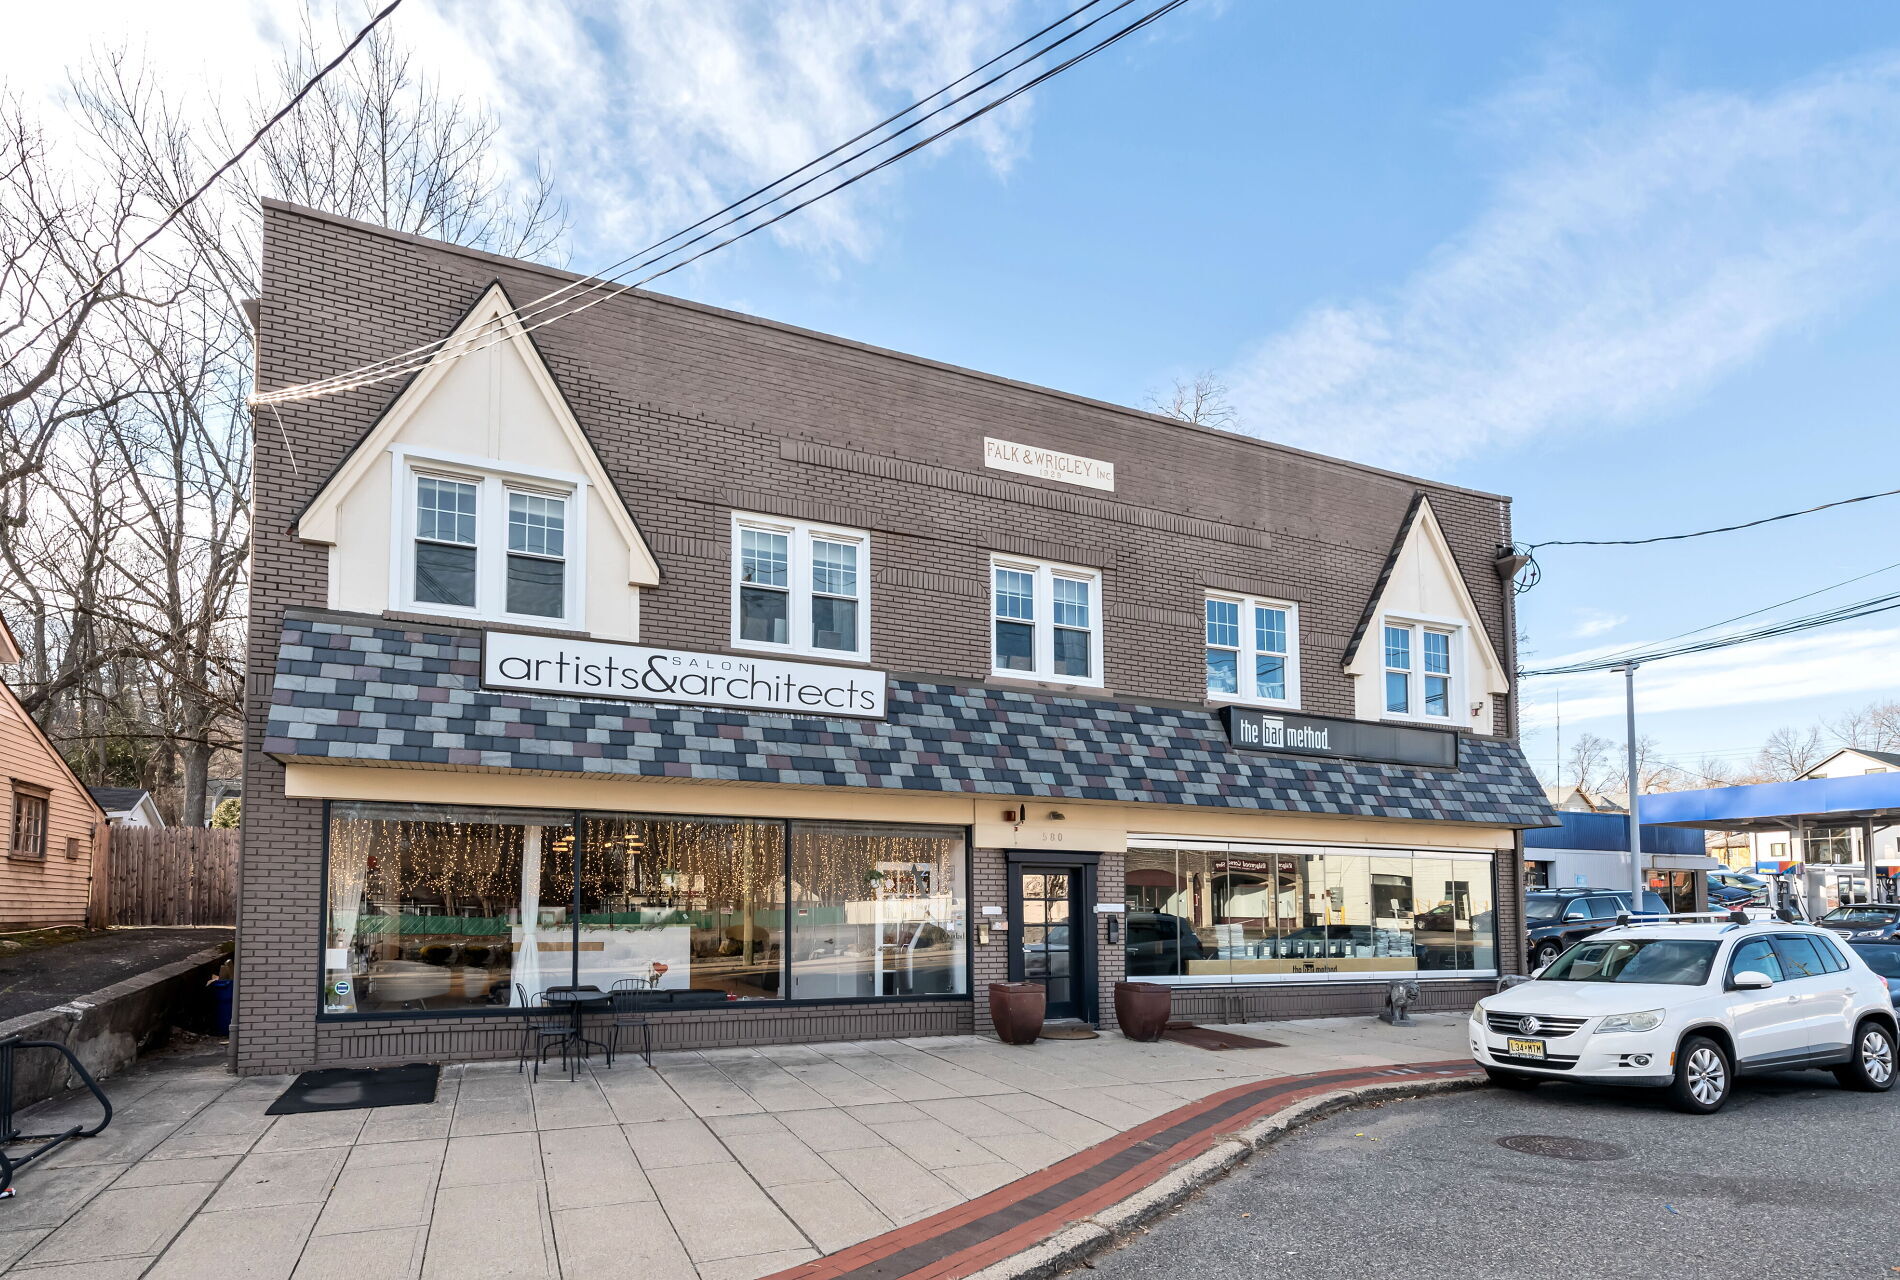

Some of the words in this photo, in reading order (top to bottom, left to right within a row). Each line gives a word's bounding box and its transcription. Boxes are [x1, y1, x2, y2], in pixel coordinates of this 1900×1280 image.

[987, 441, 1019, 463] FALK
[1022, 449, 1033, 465] &
[1035, 451, 1093, 477] WRIGLEY
[672, 656, 750, 673] SALON
[1240, 719, 1259, 743] the
[1263, 715, 1284, 748] bar
[1287, 727, 1328, 750] method
[1041, 832, 1063, 842] 580
